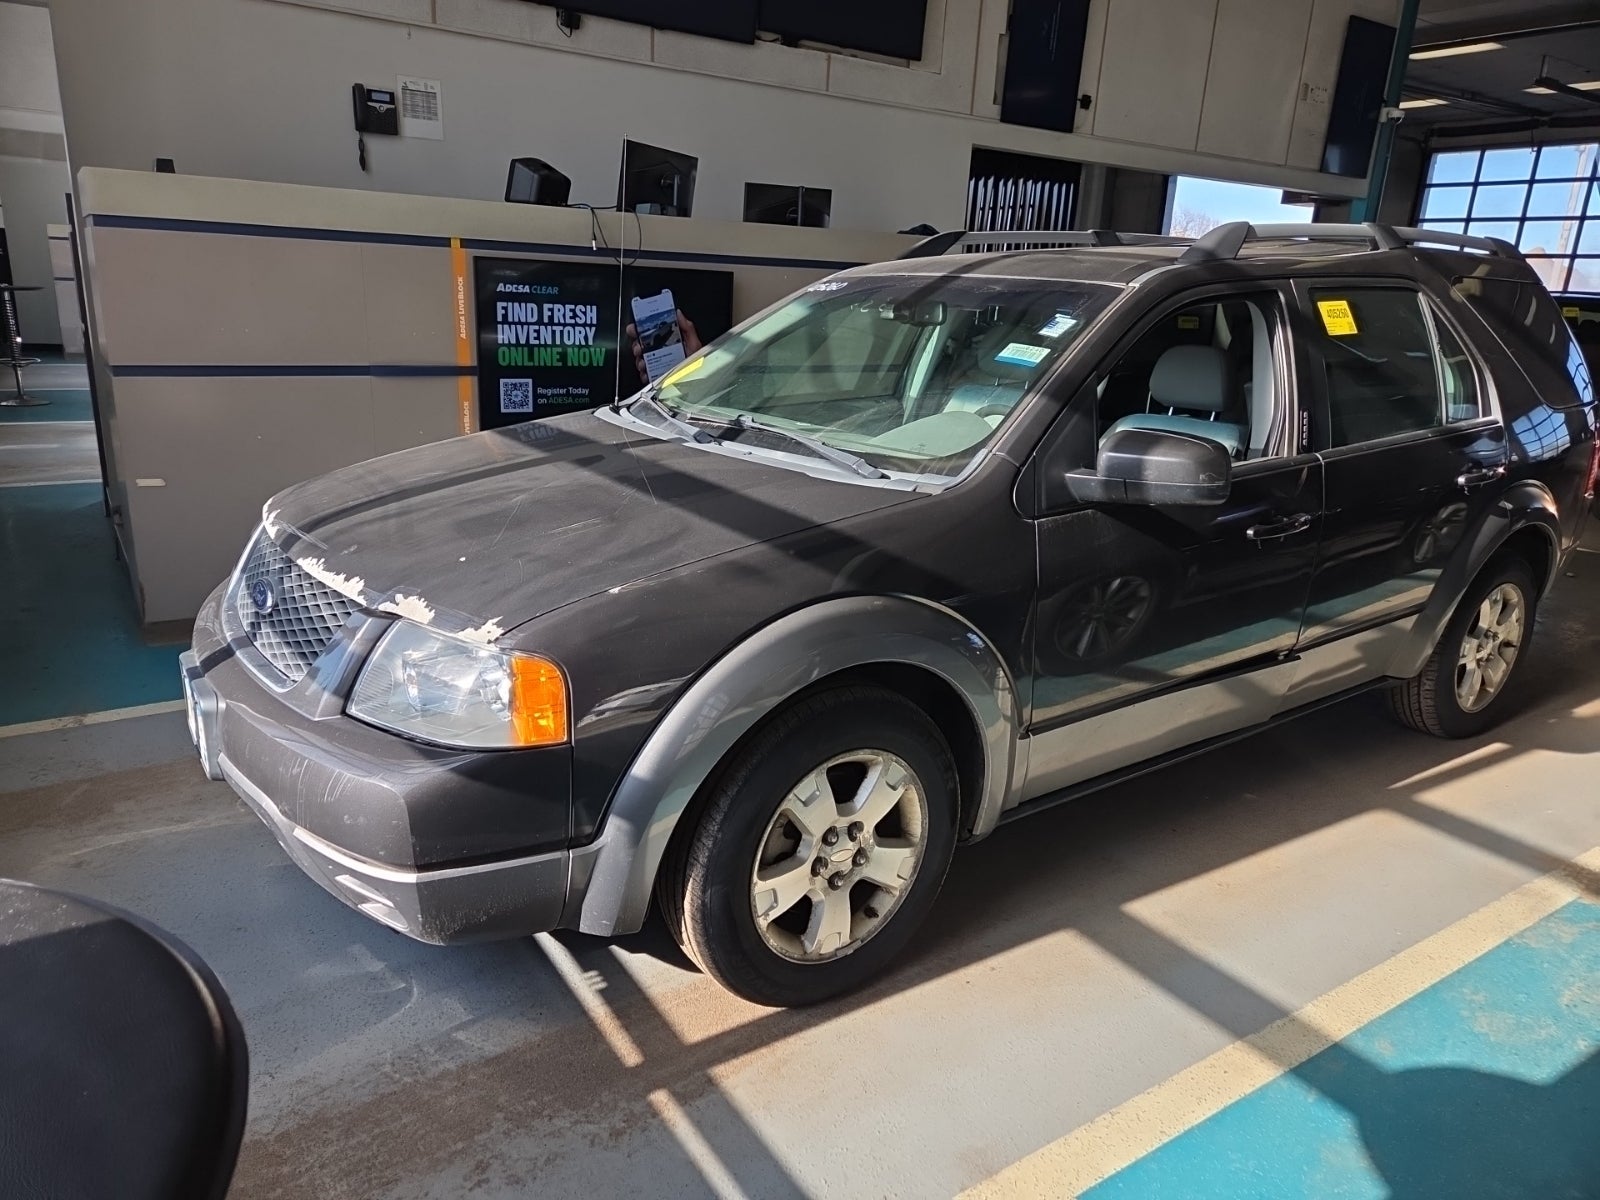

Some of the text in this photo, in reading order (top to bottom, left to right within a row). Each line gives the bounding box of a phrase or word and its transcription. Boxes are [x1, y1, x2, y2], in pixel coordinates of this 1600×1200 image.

[496, 282, 560, 295] ADESA CLEAR
[496, 301, 597, 325] FIND FRESH
[497, 324, 596, 346] INVENTORY
[497, 346, 606, 367] ONLINE NOW
[537, 387, 590, 396] Register Today
[548, 396, 590, 405] ADESA.com
